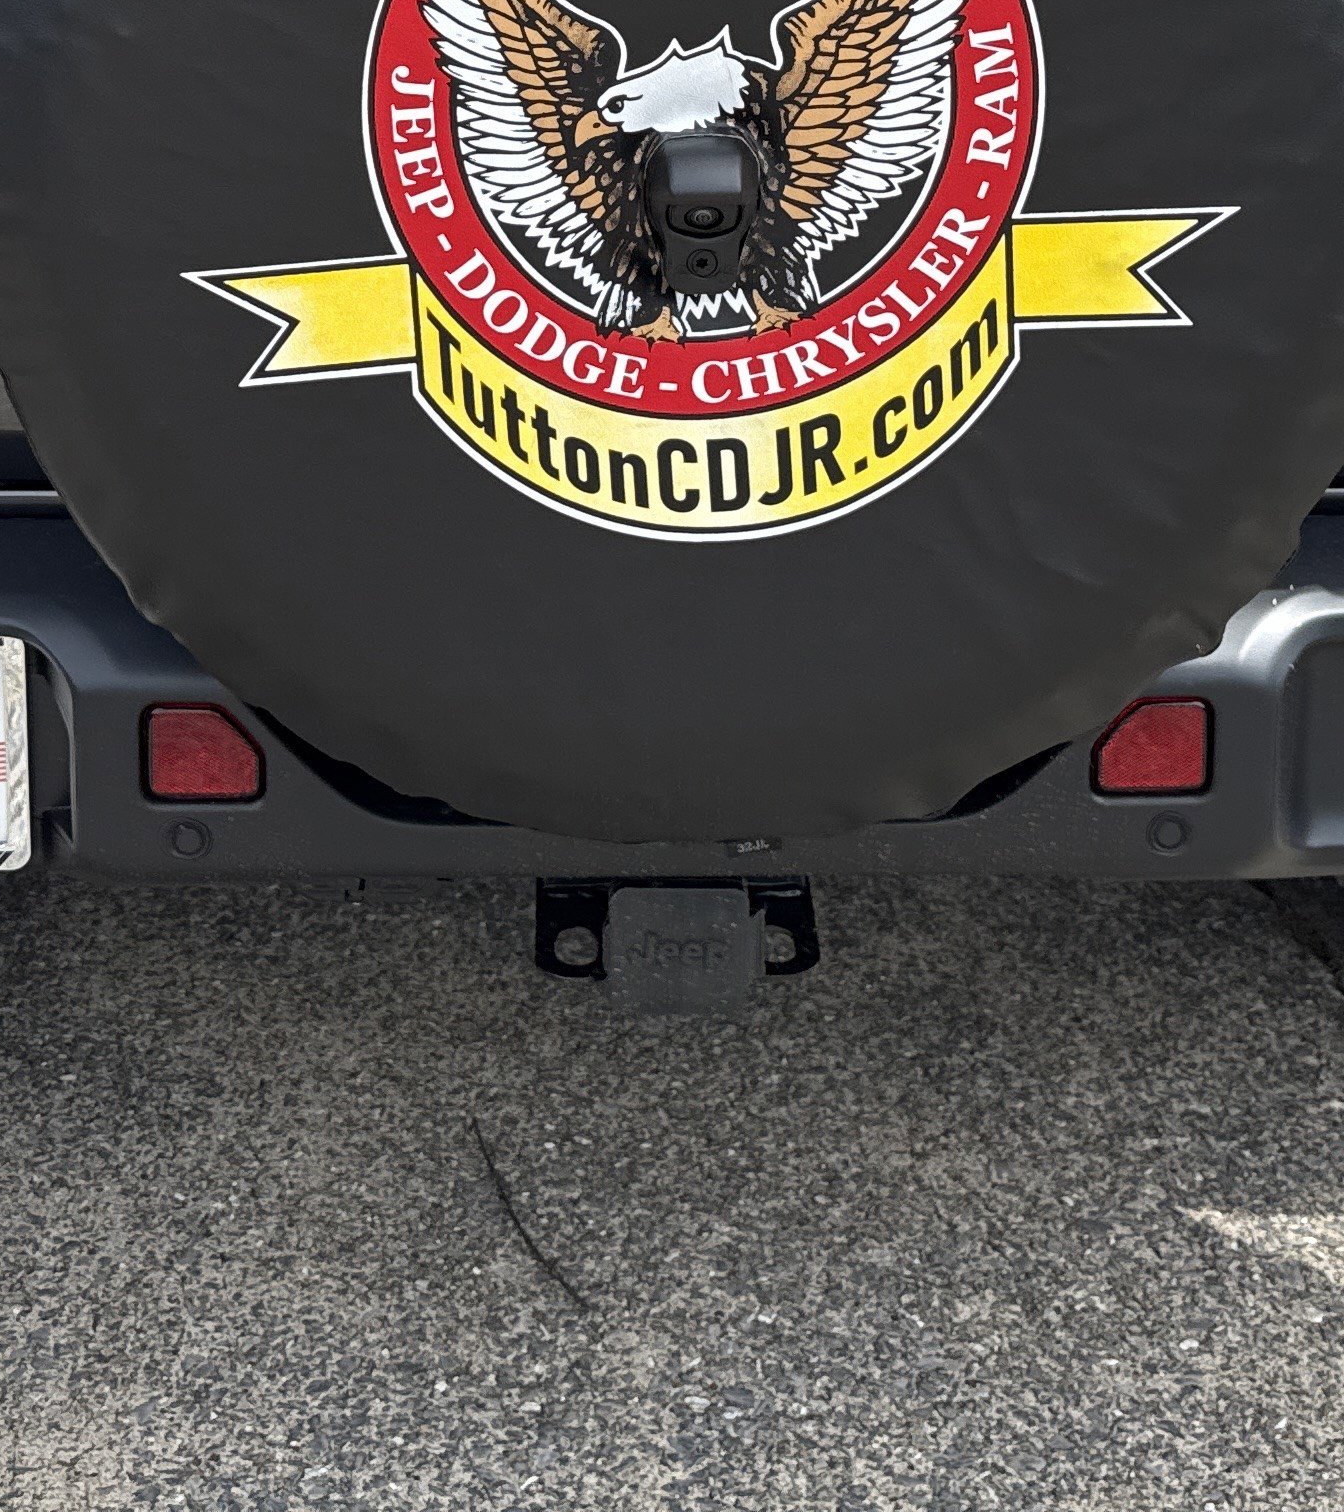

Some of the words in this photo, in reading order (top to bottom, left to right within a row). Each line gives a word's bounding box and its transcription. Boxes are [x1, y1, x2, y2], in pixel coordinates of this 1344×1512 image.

[392, 64, 455, 218] JEEP
[444, 252, 643, 400] DODGE
[691, 210, 987, 405] CHRYSLER
[968, 22, 1019, 171] RAM
[425, 297, 1001, 515] TuttonCDJR.com
